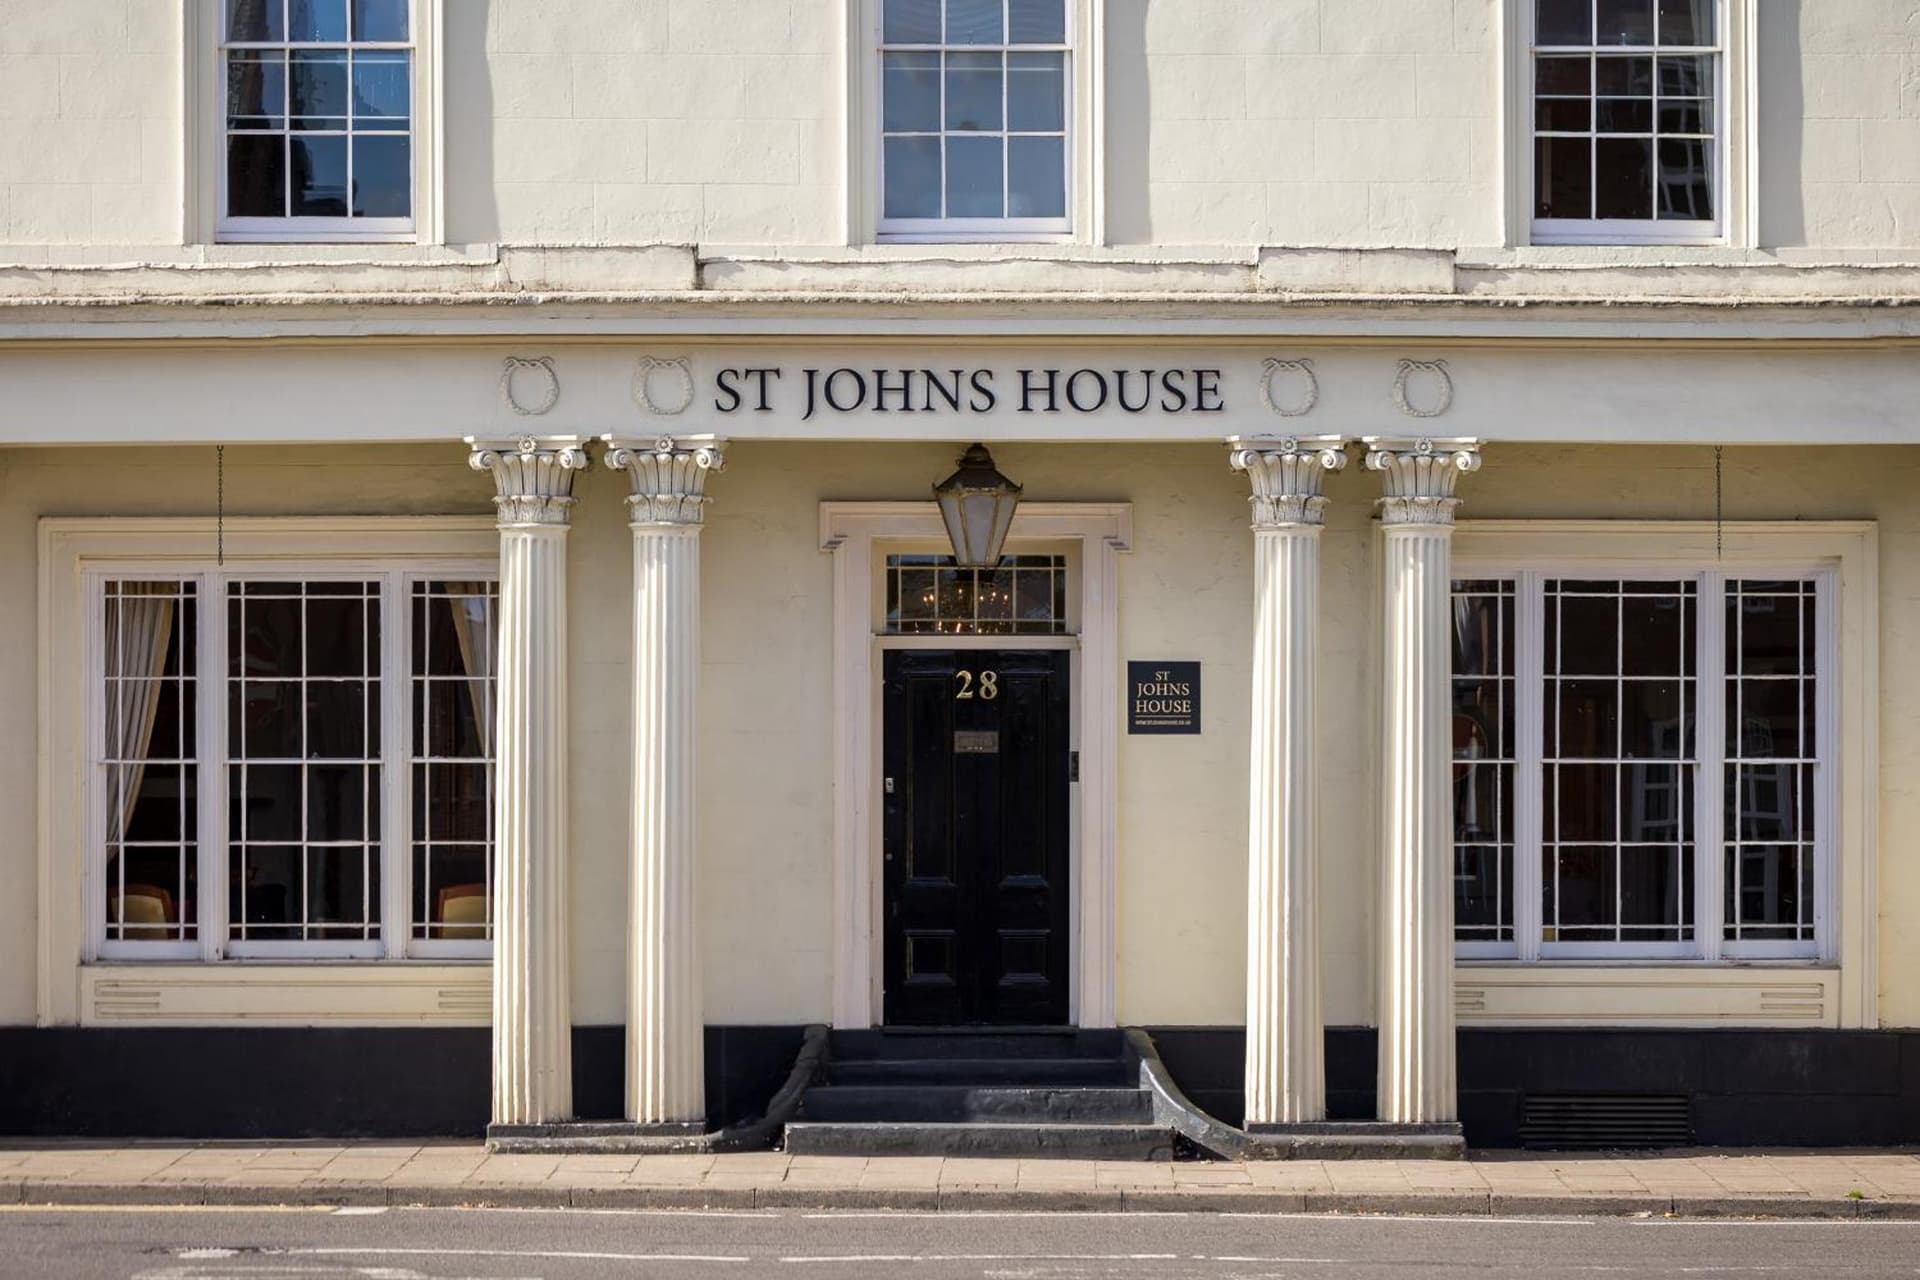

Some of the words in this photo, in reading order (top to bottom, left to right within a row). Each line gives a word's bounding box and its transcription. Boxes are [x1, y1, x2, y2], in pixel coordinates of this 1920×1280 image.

[714, 367, 781, 413] ST
[801, 367, 996, 420] JOHNS
[1015, 368, 1225, 413] HOUSE
[1155, 671, 1171, 681] ST
[956, 670, 998, 699] 28
[1136, 682, 1190, 698] JOHNS
[1135, 699, 1192, 713] HOUSE
